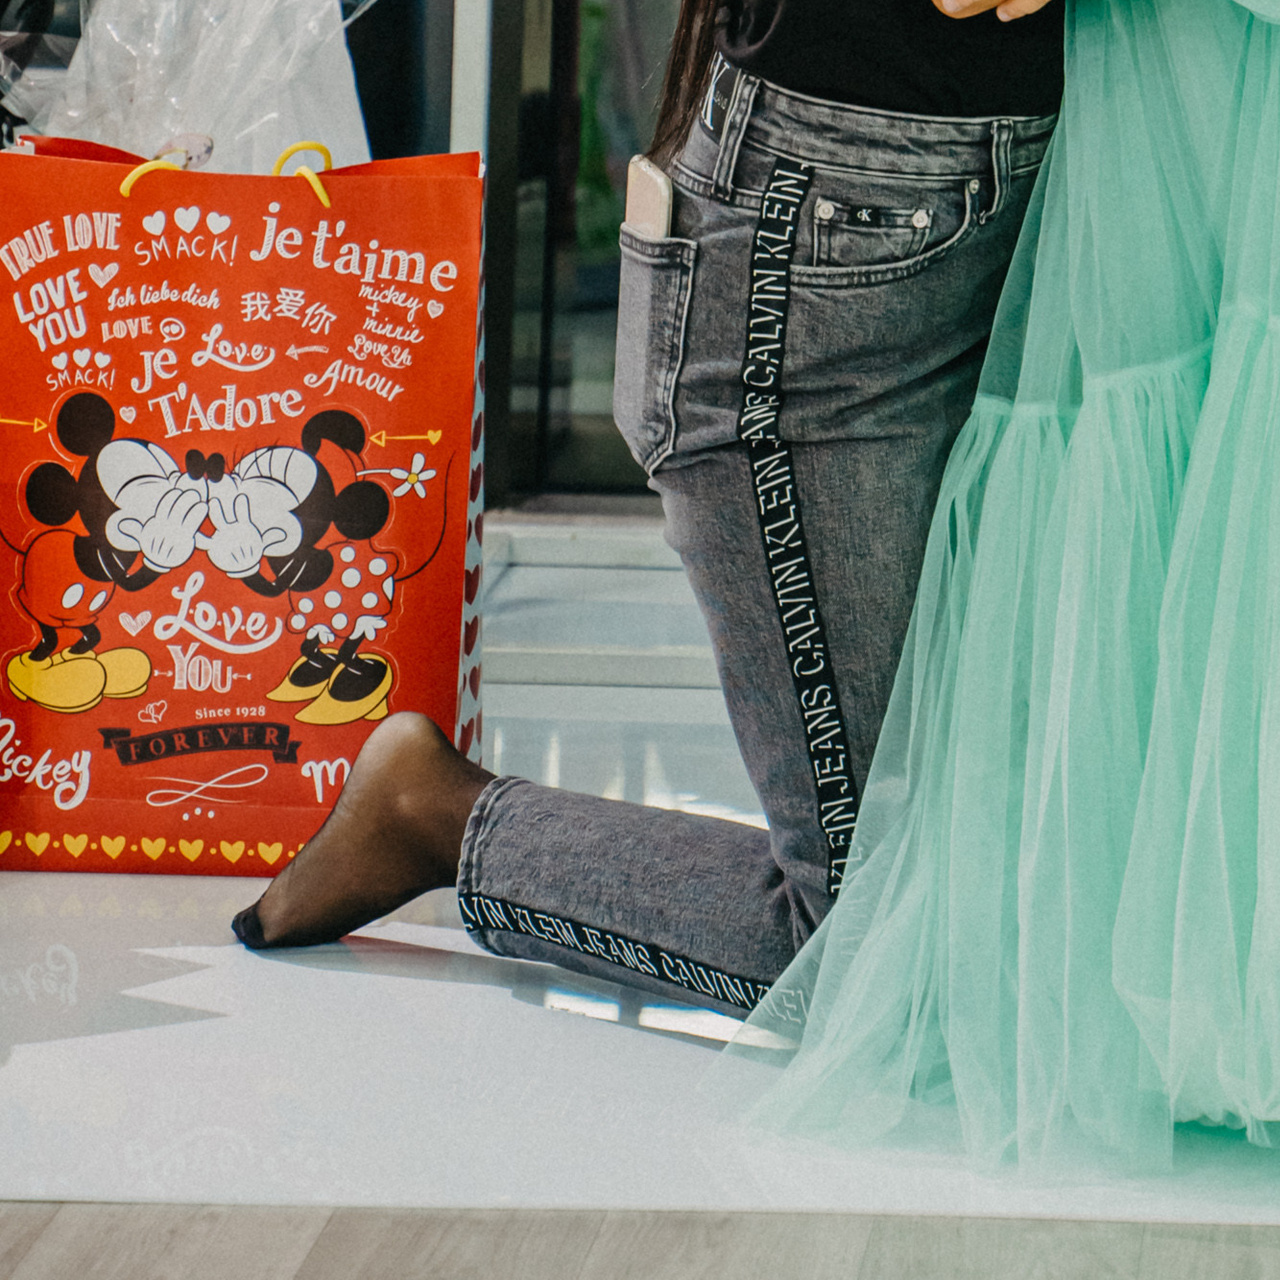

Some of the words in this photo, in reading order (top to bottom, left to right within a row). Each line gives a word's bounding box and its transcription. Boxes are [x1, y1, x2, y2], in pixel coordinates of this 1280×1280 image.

[753, 168, 810, 261] KLEIN
[0, 221, 60, 281] TRUE
[62, 211, 122, 252] LOVE
[134, 235, 238, 267] SMACK!
[249, 201, 303, 261] je
[311, 220, 458, 292] t'aime
[12, 268, 88, 324] LOVE
[107, 286, 136, 311] Ich
[140, 279, 181, 306] liebe
[181, 282, 220, 310] dich
[240, 287, 338, 335] 我爱你
[28, 304, 88, 352] YOU
[101, 316, 153, 343] LOVE
[347, 333, 388, 361] Love
[382, 344, 413, 369] Ya
[743, 269, 787, 388] CALVIN
[46, 368, 116, 391] SMACK!
[303, 359, 405, 402] Amour
[147, 382, 306, 439] T'Adore
[753, 450, 803, 559] KLEIN
[771, 556, 824, 678] CALVIN
[195, 707, 231, 720] Since
[235, 705, 266, 717] 1928
[128, 726, 281, 762] FOREVER
[801, 684, 850, 794] JEANS
[507, 904, 584, 952] KLEIN
[582, 926, 659, 977] JEANS
[659, 951, 753, 1010] CALVIN
